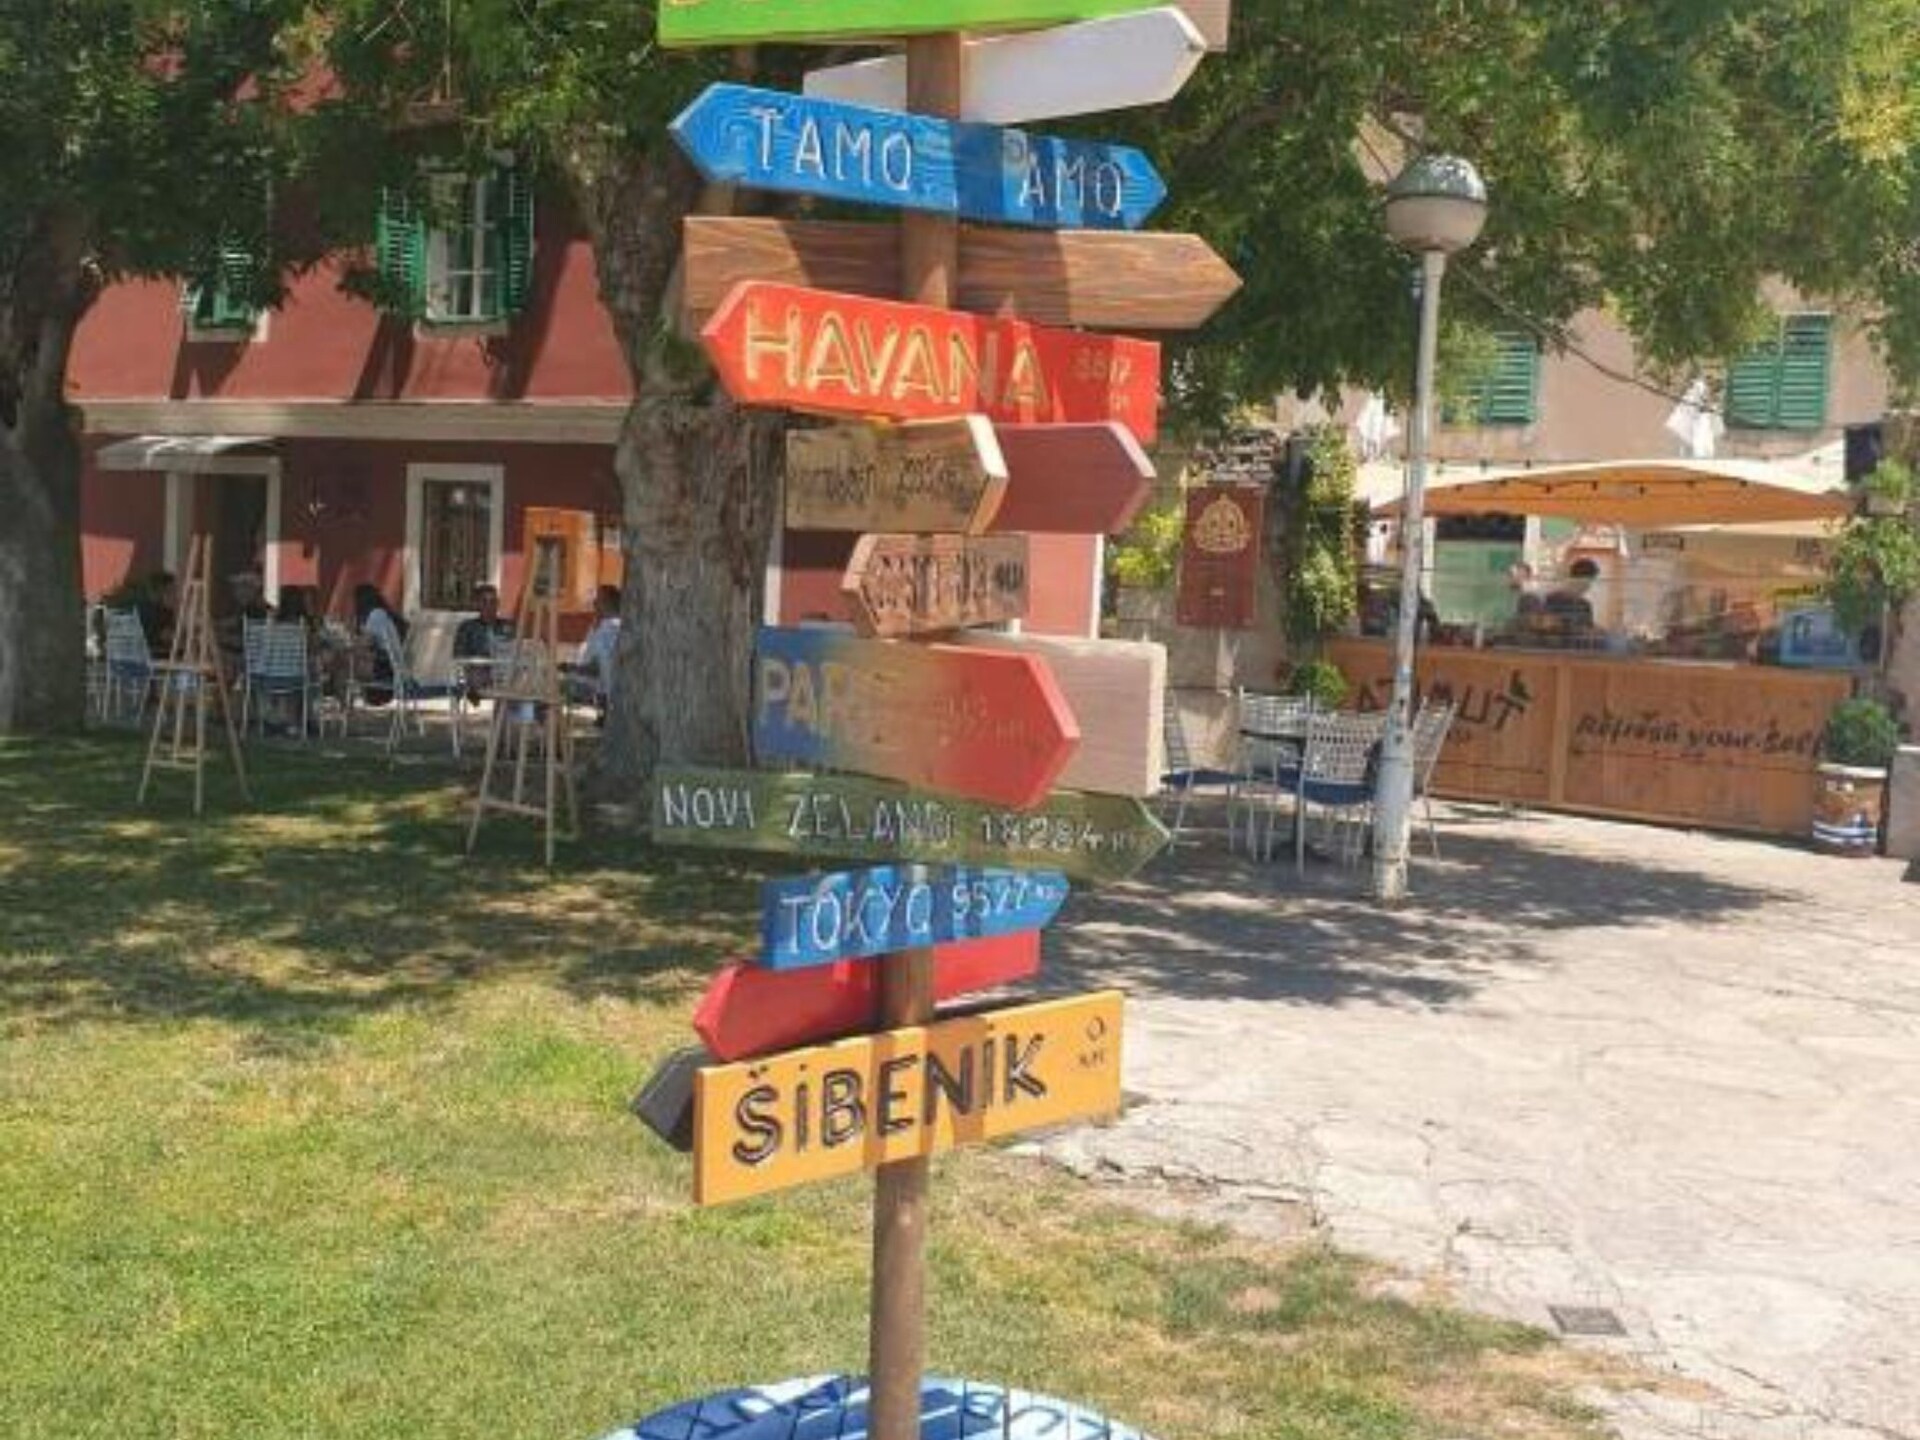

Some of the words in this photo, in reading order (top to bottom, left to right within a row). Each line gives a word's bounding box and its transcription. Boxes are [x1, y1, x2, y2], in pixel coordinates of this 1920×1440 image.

[751, 107, 912, 190] TAMO
[744, 297, 1050, 412] HAVANA
[662, 784, 755, 829] NOVI
[780, 883, 932, 954] TOKYO
